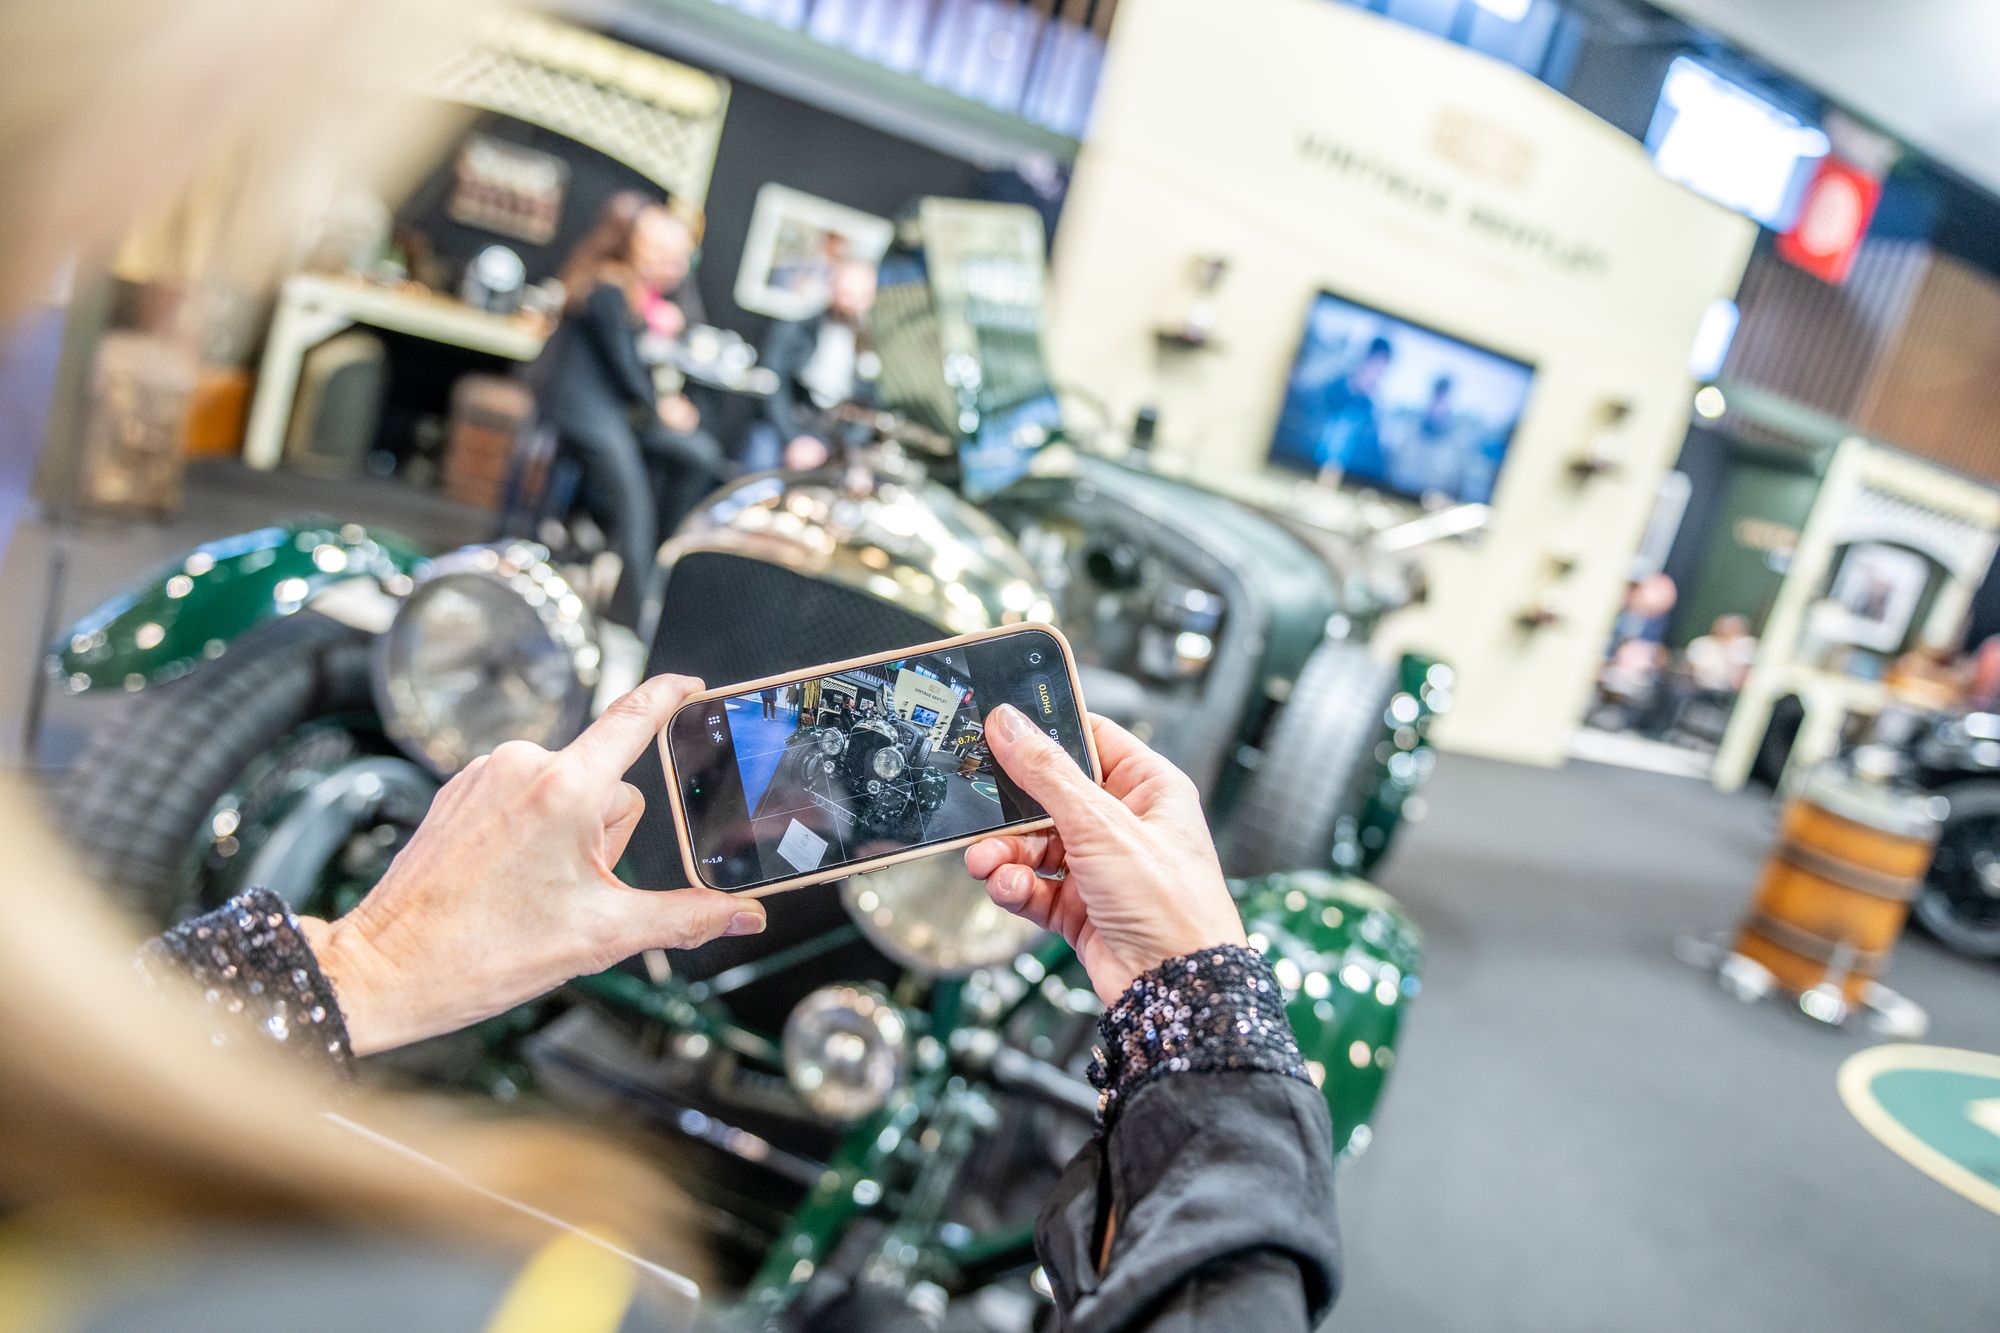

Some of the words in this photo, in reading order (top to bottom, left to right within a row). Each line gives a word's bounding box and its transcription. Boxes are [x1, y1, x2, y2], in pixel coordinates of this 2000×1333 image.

[945, 656, 952, 665] 8
[914, 687, 932, 698] VINTAGE
[932, 695, 948, 704] BENTLEY
[1038, 683, 1053, 714] PHOTO
